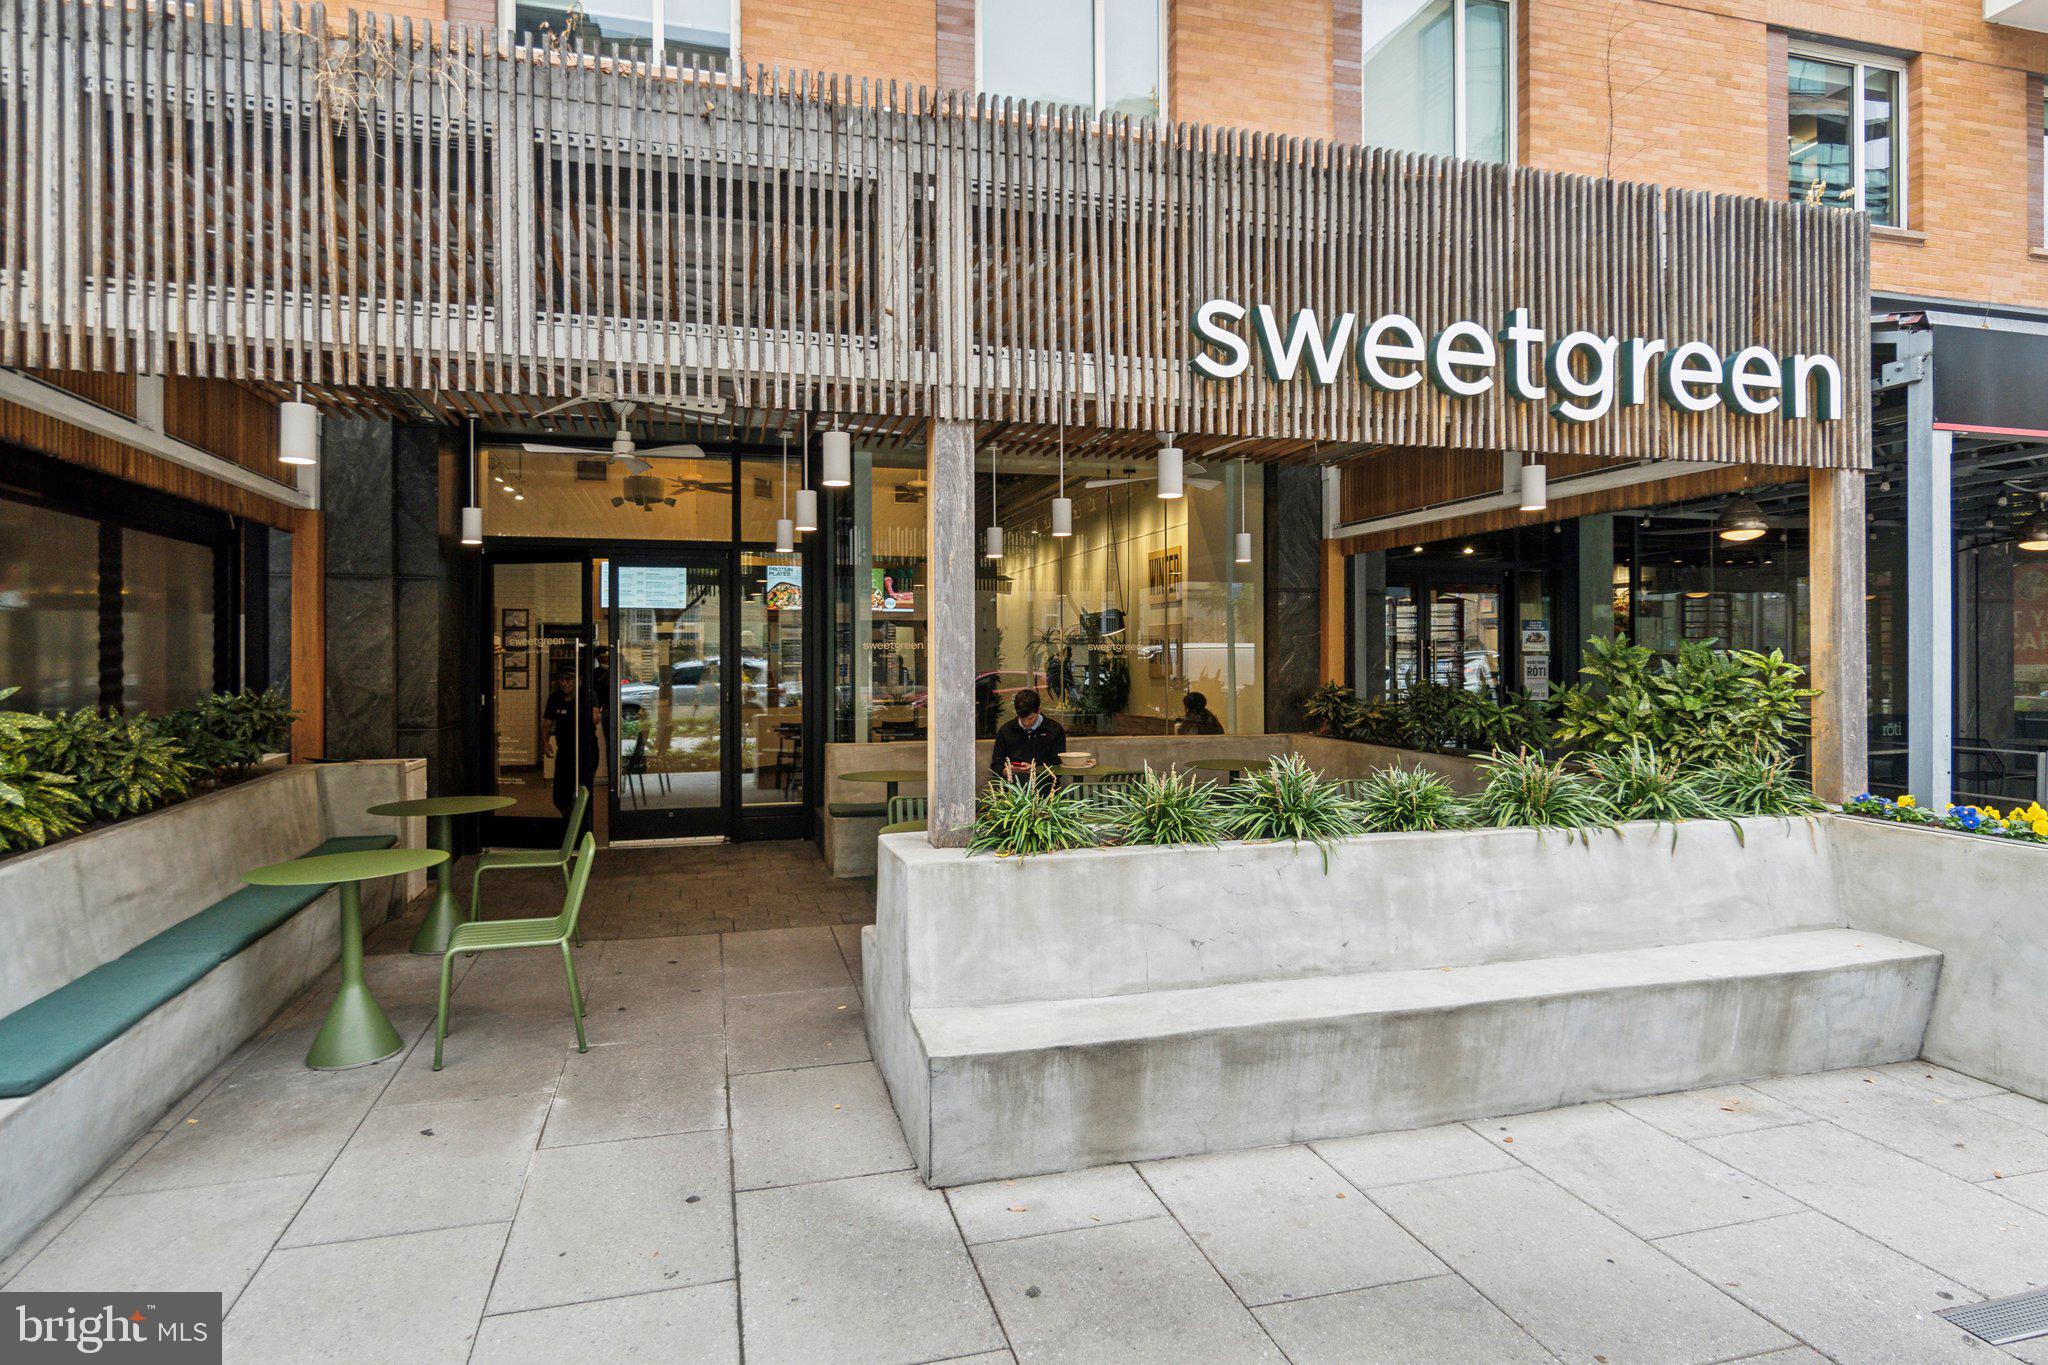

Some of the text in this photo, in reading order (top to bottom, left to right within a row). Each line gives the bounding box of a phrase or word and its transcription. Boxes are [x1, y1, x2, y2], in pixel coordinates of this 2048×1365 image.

[1192, 298, 1843, 423] sweetgreen
[509, 637, 565, 648] sweetgreen
[862, 642, 924, 652] sweetgreen
[1087, 643, 1142, 653] sweetgreen
